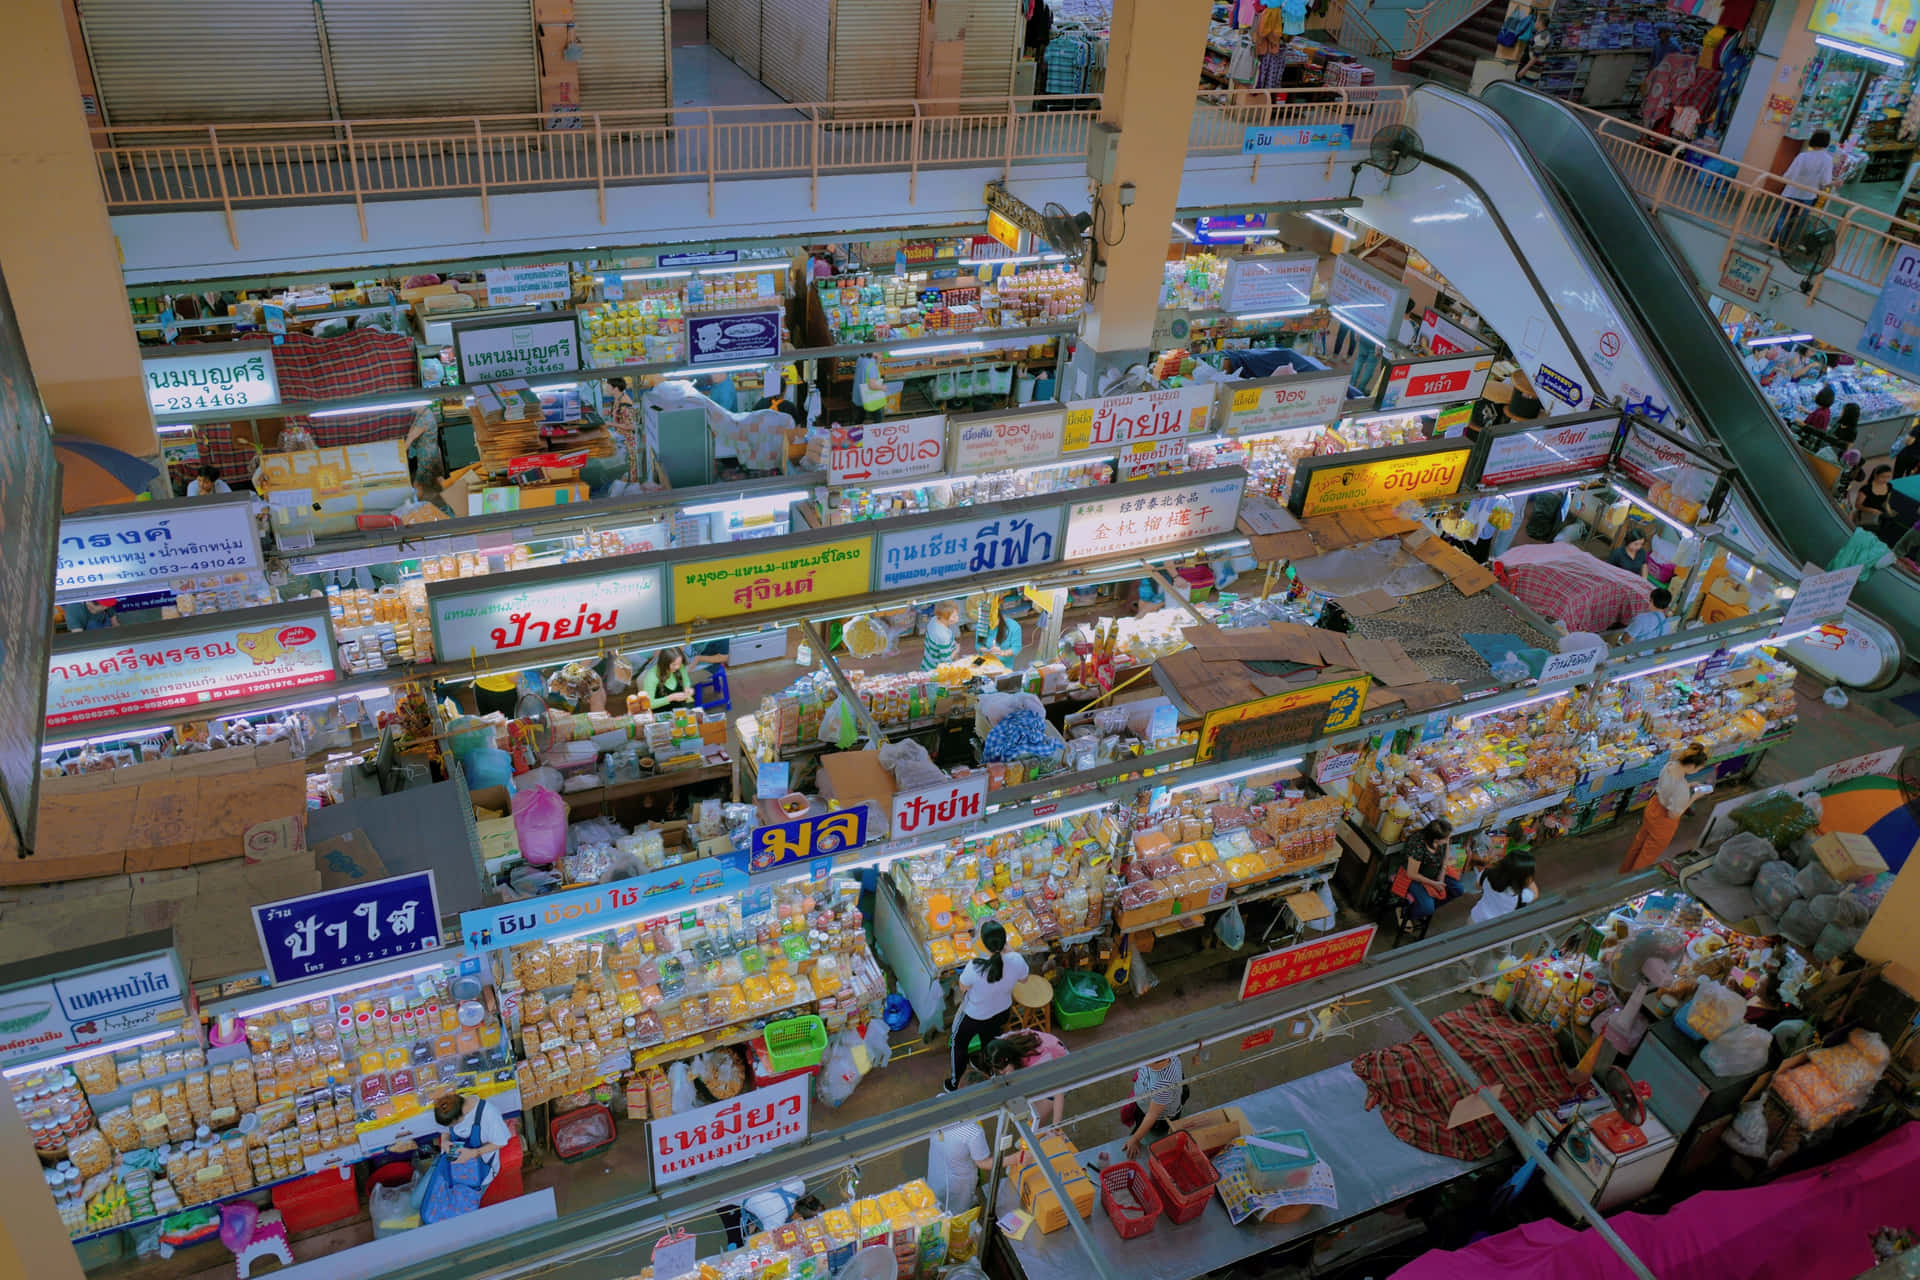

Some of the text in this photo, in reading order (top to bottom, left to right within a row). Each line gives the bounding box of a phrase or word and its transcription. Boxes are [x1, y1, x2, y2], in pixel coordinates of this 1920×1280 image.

[1257, 133, 1272, 146] ชิม
[467, 338, 571, 367] แหนมบุญศรี
[145, 356, 265, 394] นมบุญศรี
[1273, 390, 1306, 404] จอย
[1090, 403, 1183, 446] ป้าย่น
[158, 537, 244, 559] น้ำพริกหนุ่ม
[887, 533, 969, 569] กุนเชียง
[970, 518, 1053, 573] มีฟ้า
[148, 556, 247, 577] 053-491042
[733, 570, 817, 609] สุจินต์
[490, 603, 619, 650] ป้าย่น
[224, 688, 240, 697] Line
[898, 789, 980, 832] ป้าย่น
[762, 812, 860, 864] มล
[267, 908, 292, 921] ร้าน
[499, 887, 638, 935] ชิม ช้อป ใช้
[69, 971, 170, 1011] แหนมป้าใส
[659, 1094, 801, 1156] เหมียว
[662, 1121, 801, 1175] แหนมป้าย่น
